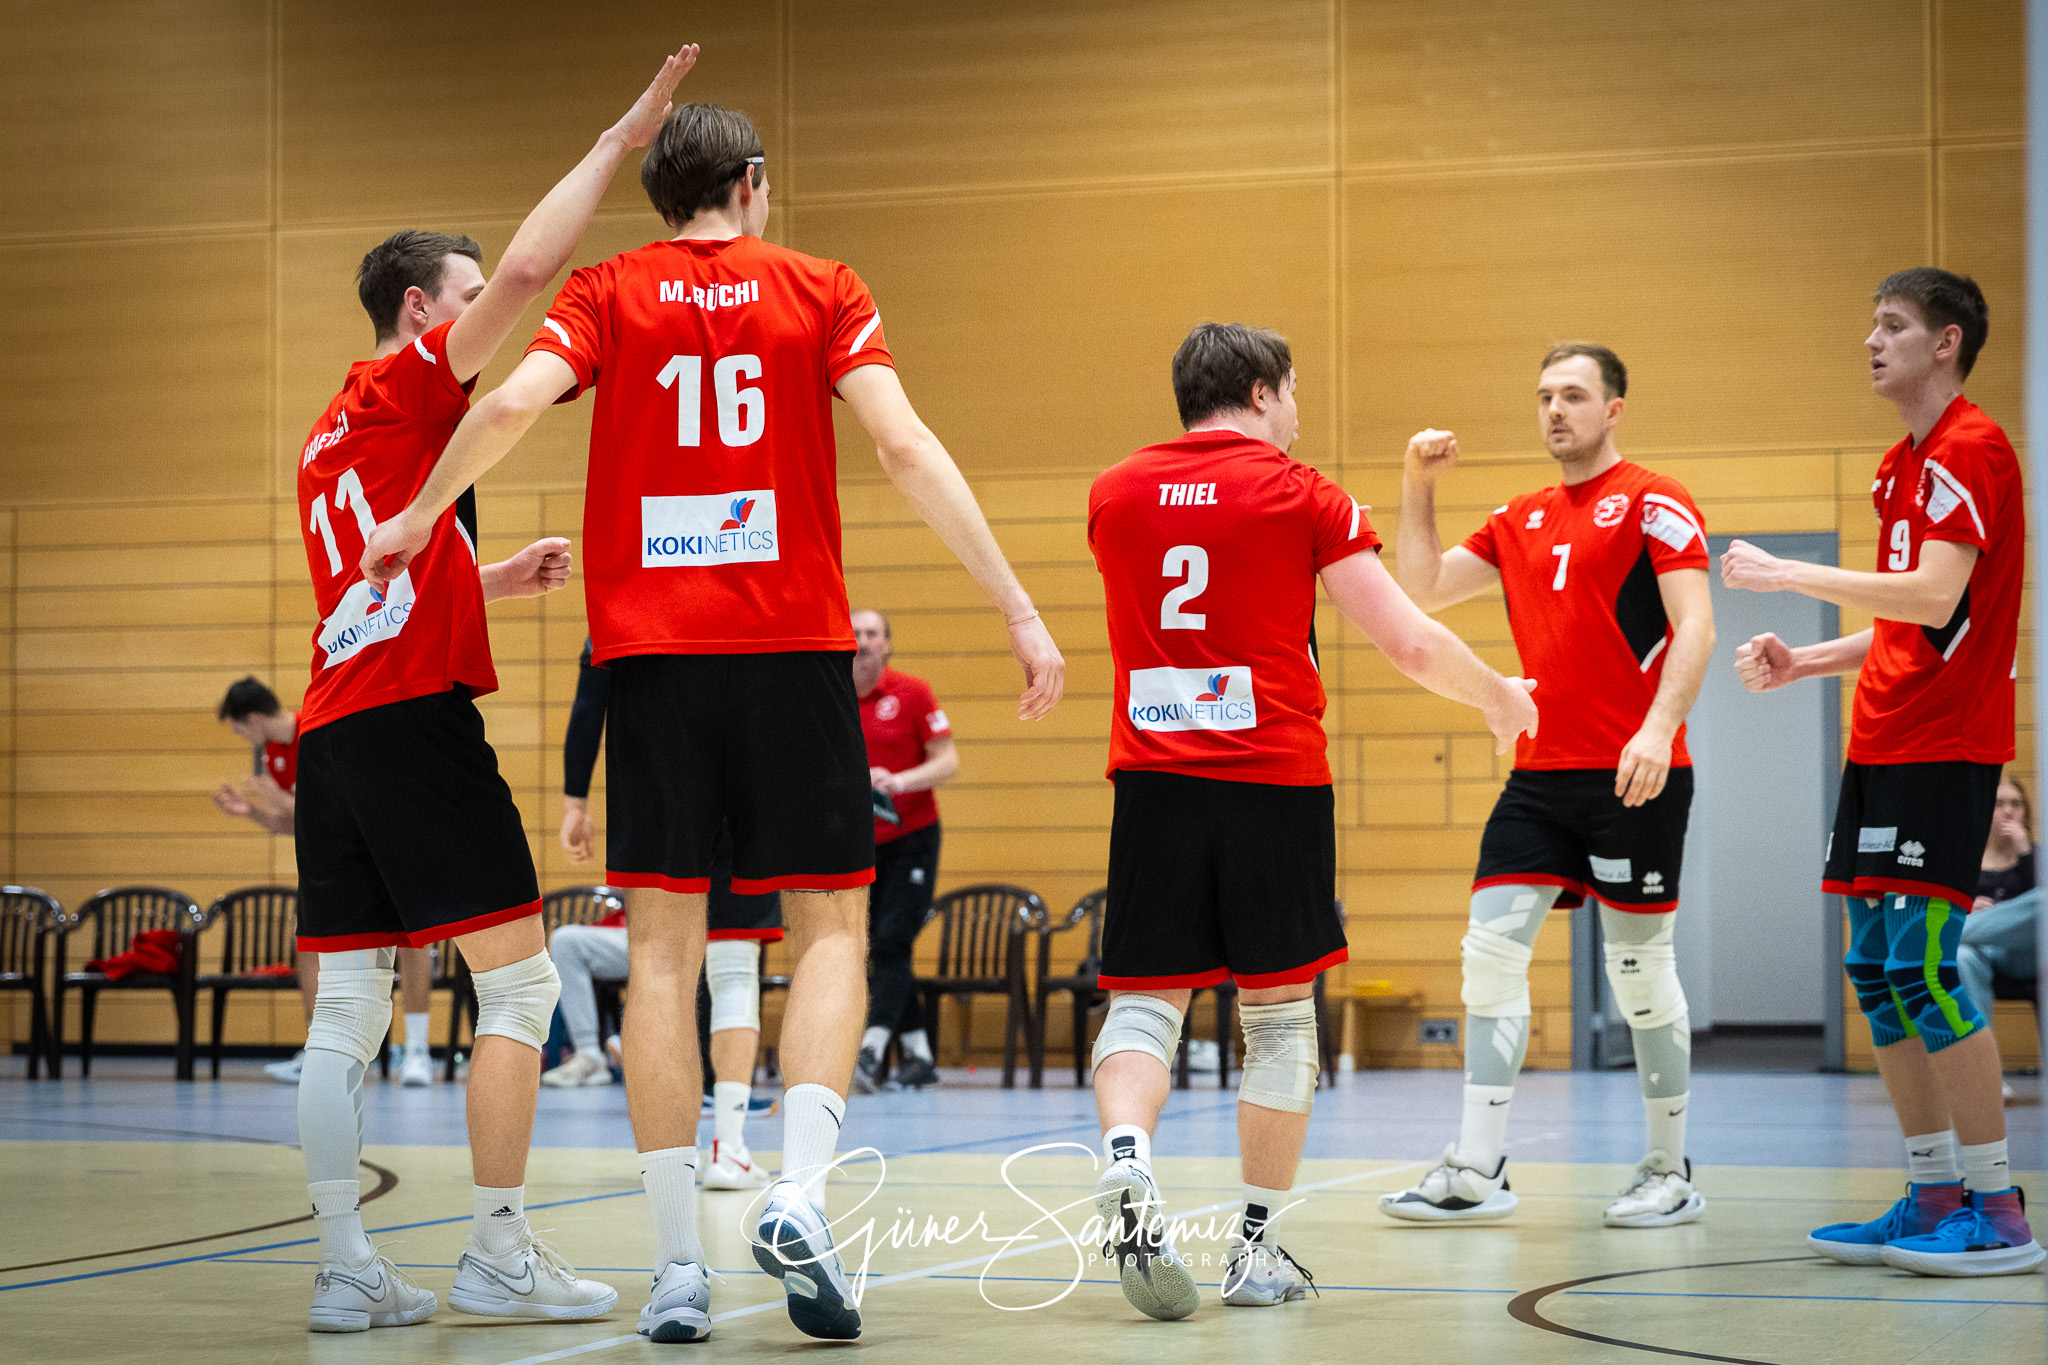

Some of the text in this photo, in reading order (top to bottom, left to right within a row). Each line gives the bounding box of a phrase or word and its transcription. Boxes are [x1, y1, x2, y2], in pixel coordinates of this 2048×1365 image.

[659, 280, 760, 312] M.BÜCHI
[655, 354, 766, 447] 16
[1158, 482, 1219, 506] THIEL
[309, 467, 379, 578] 11
[647, 530, 774, 556] KOKINETICS
[1888, 519, 1911, 571] 9
[1160, 544, 1210, 631] 2
[1551, 543, 1572, 591] 7
[1132, 701, 1252, 723] KOKINETICS
